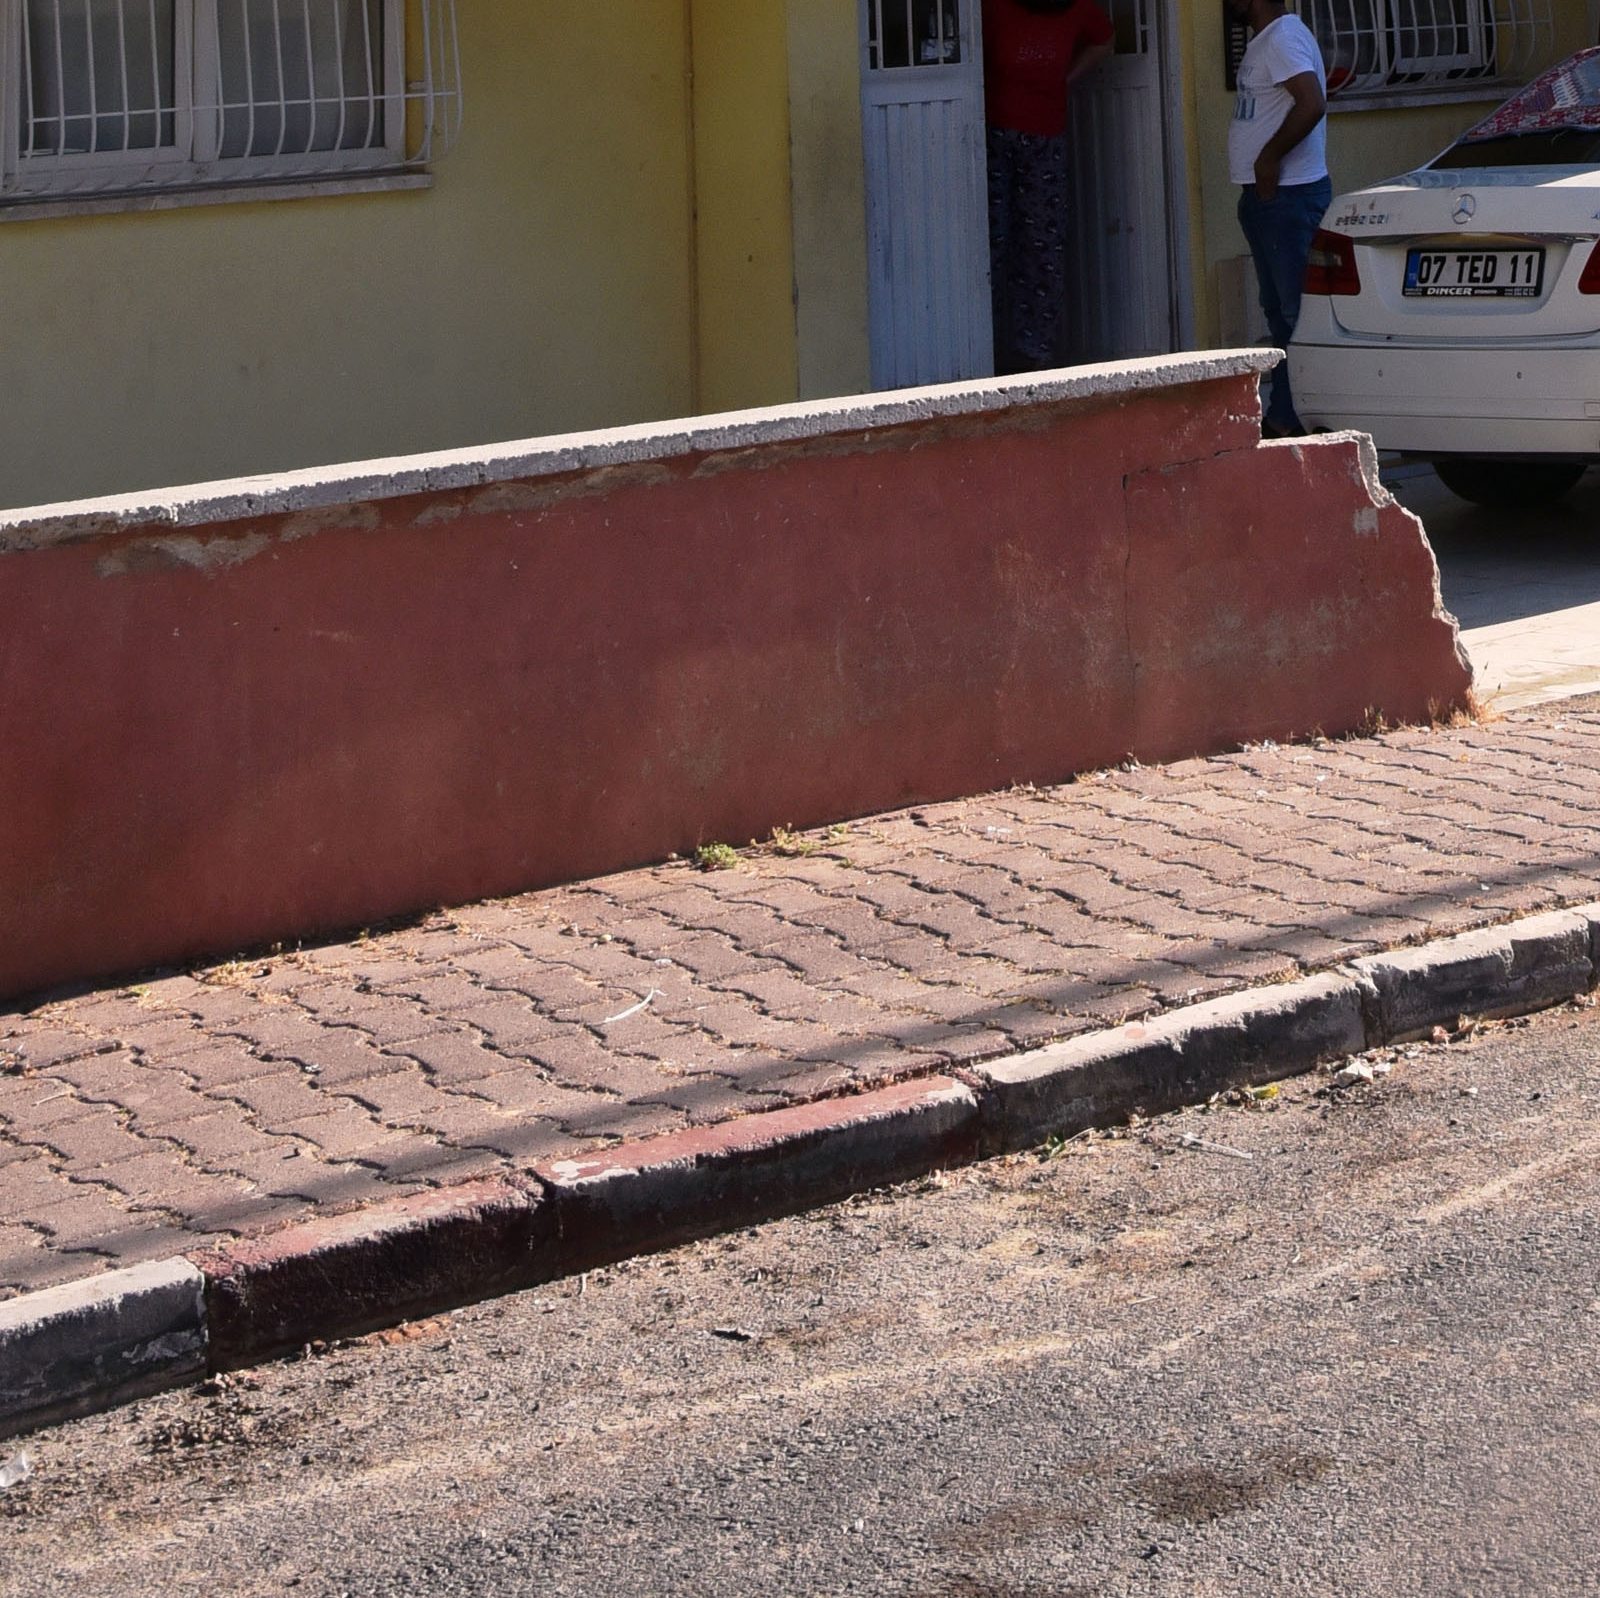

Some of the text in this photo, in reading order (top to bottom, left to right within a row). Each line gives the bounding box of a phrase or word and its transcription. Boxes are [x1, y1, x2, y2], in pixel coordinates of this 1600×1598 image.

[1418, 254, 1534, 284] 07 TED 11
